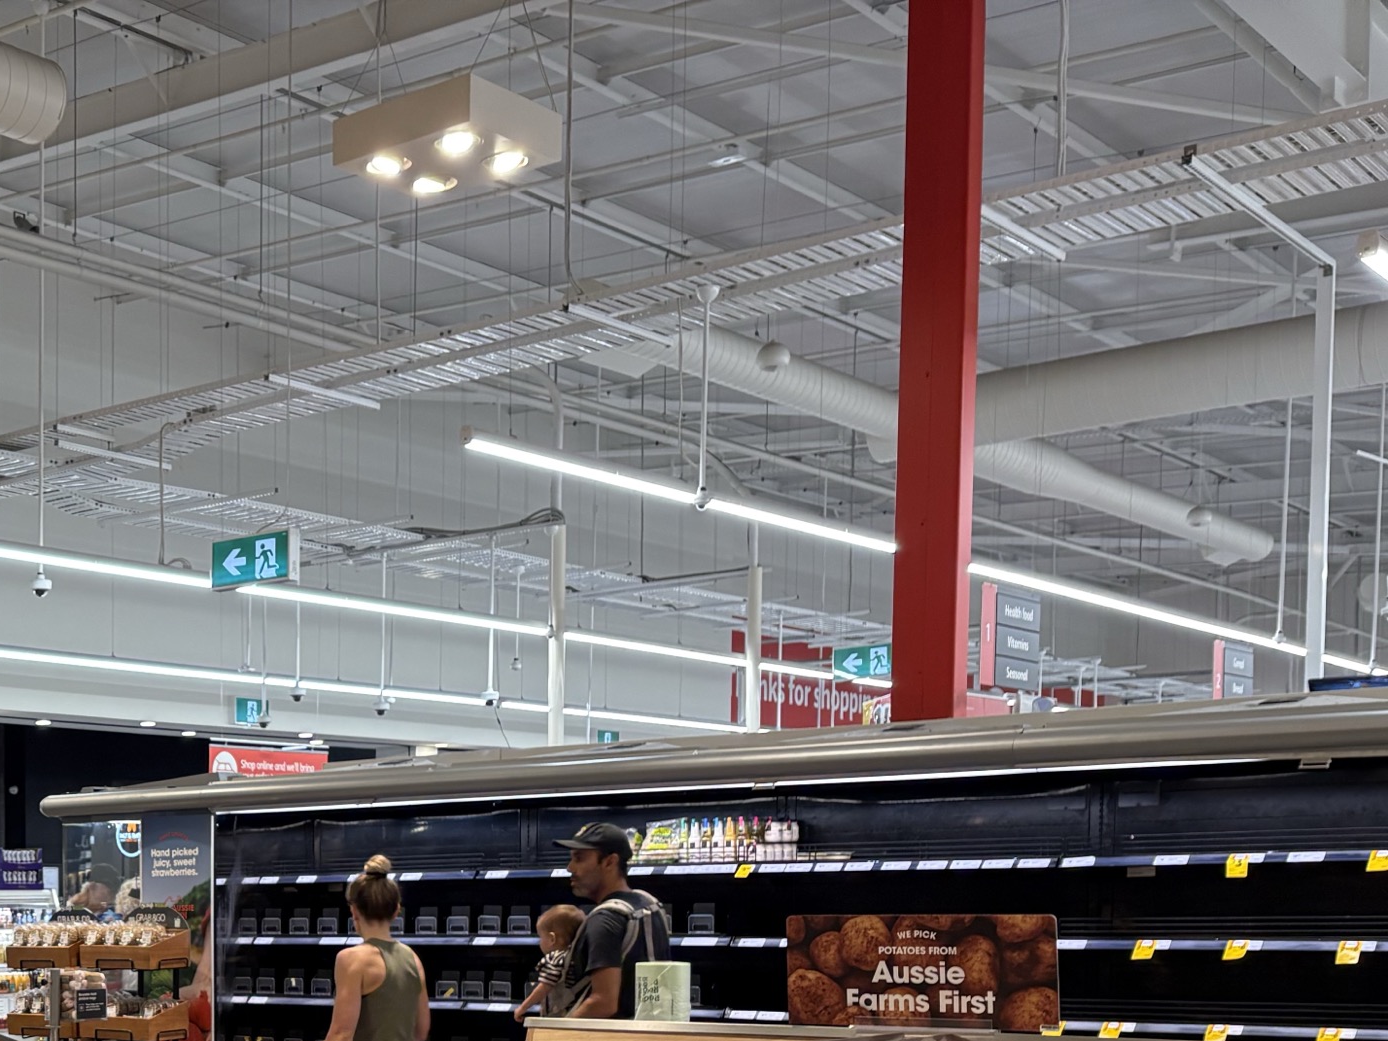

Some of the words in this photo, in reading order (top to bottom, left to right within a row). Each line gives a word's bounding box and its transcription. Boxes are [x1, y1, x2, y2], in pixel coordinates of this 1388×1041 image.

[1005, 604, 1022, 618] Health
[1022, 607, 1033, 621] food
[985, 623, 991, 641] 1
[1007, 636, 1029, 651] Vitamins
[1006, 666, 1028, 681] Seasonal
[761, 672, 785, 703] nks
[788, 675, 811, 707] for
[813, 679, 878, 722] shoppi
[240, 760, 256, 771] Shop
[256, 761, 274, 770] online
[274, 761, 286, 771] and
[151, 848, 170, 857] Hand
[172, 847, 199, 858] picked
[153, 858, 171, 868] juicy,
[173, 857, 196, 866] sweet
[151, 868, 198, 877] strawberries.
[897, 930, 912, 940] WE
[913, 930, 937, 941] PICK
[878, 946, 926, 955] POTATOES
[928, 946, 957, 955] FROM
[871, 961, 965, 985] Aussie
[846, 988, 929, 1012] Farms
[939, 989, 996, 1014] First
